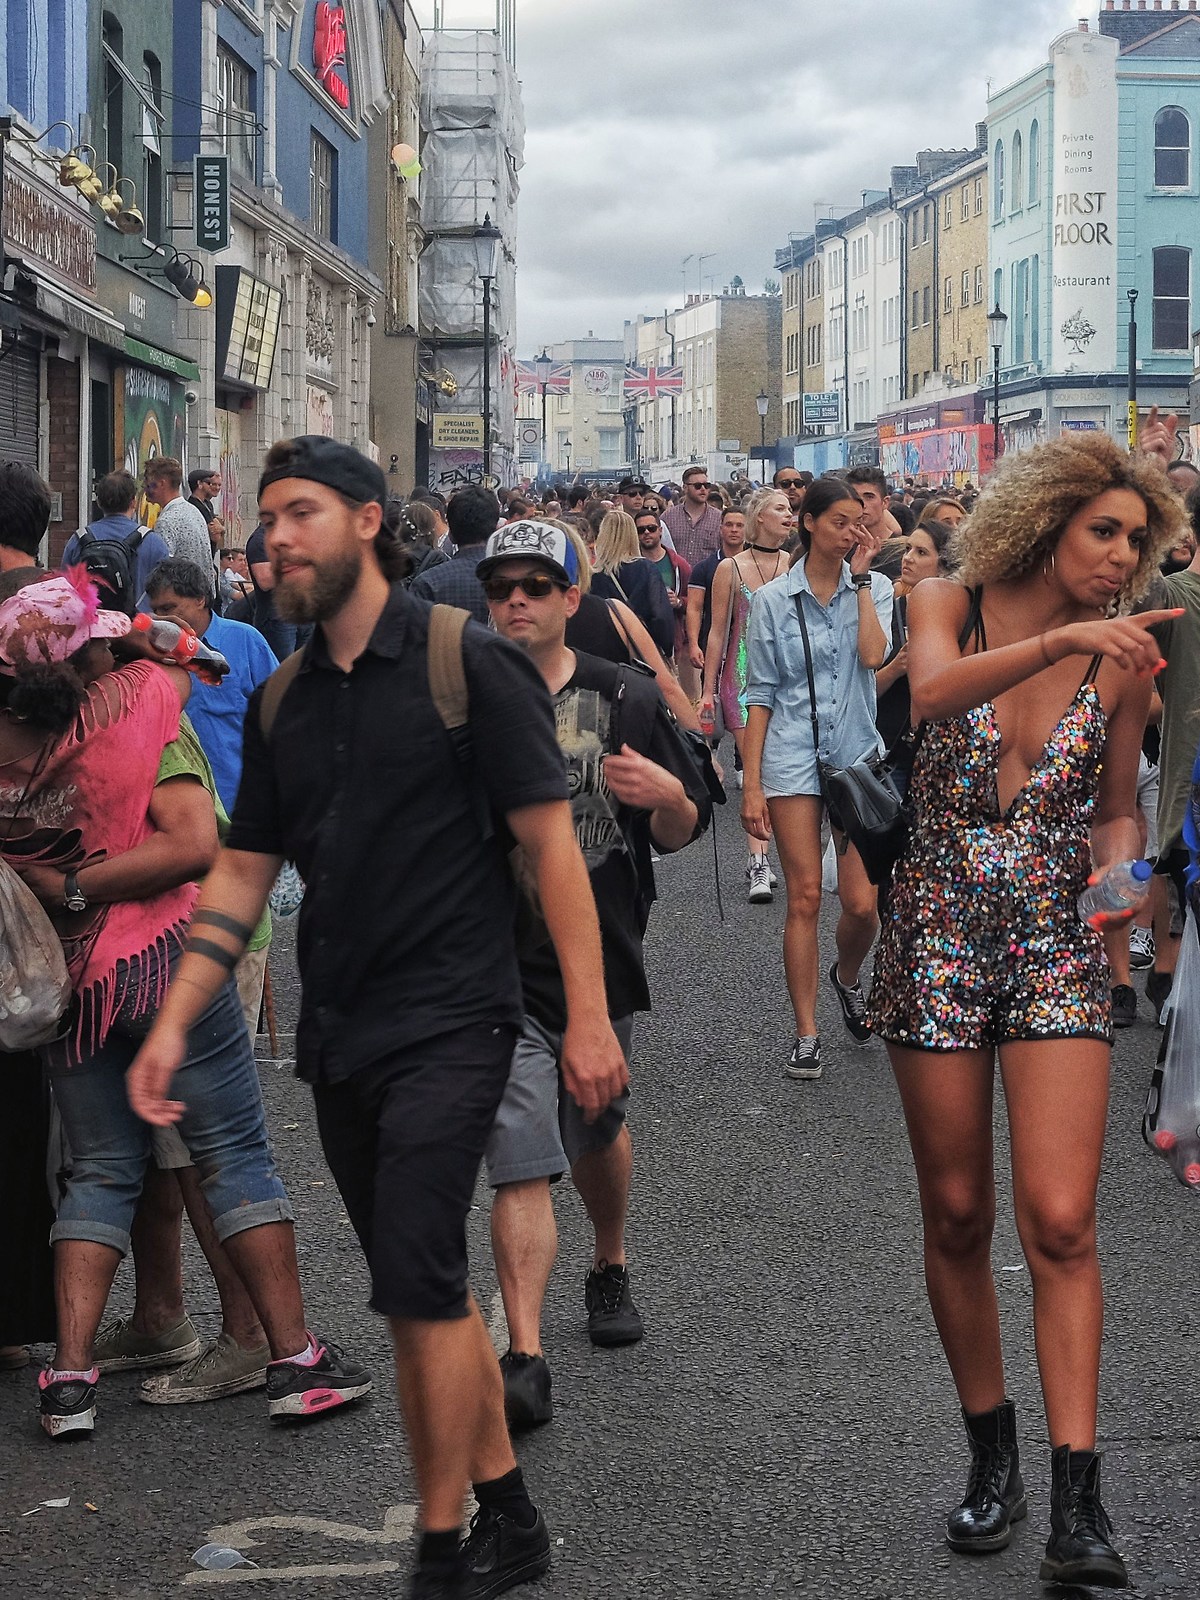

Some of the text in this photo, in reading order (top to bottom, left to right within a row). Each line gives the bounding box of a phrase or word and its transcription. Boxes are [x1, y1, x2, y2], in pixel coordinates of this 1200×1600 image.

[1062, 133, 1094, 143] Private
[1064, 149, 1093, 160] Dining
[1064, 165, 1093, 175] Rooms
[204, 164, 220, 241] HONEST
[1055, 192, 1107, 217] FIRST
[1054, 222, 1113, 247] FLOOR
[1053, 275, 1111, 287] Restaurant
